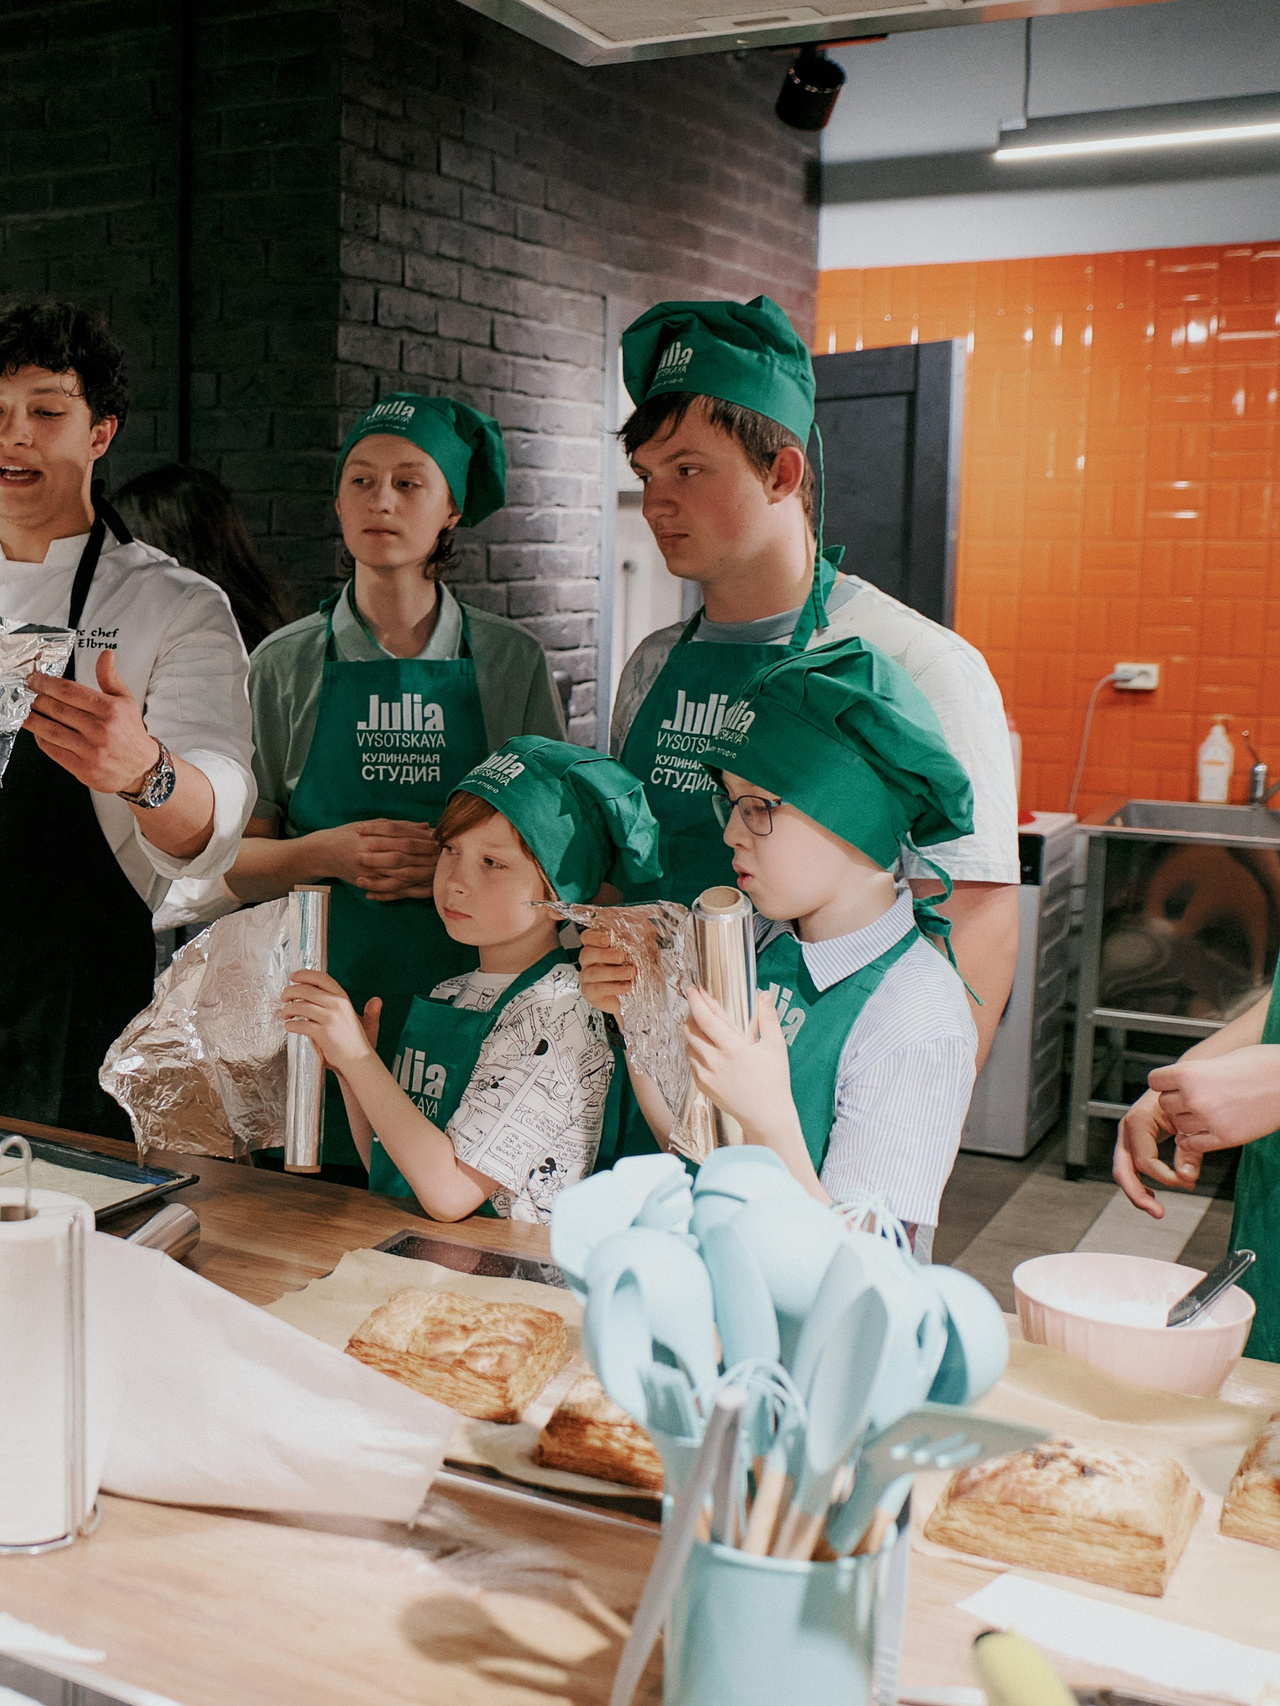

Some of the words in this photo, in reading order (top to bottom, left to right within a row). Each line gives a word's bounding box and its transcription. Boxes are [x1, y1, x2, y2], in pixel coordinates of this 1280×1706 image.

[659, 341, 694, 369] ulia
[91, 627, 119, 637] chef
[78, 638, 118, 649] Elbrus
[357, 693, 445, 731] Julia
[661, 690, 729, 736] Juli
[356, 732, 447, 748] VYSOTSKAYA
[362, 753, 440, 764] КУЛИНАРНАЯ
[361, 765, 440, 785] СТУДИЯ
